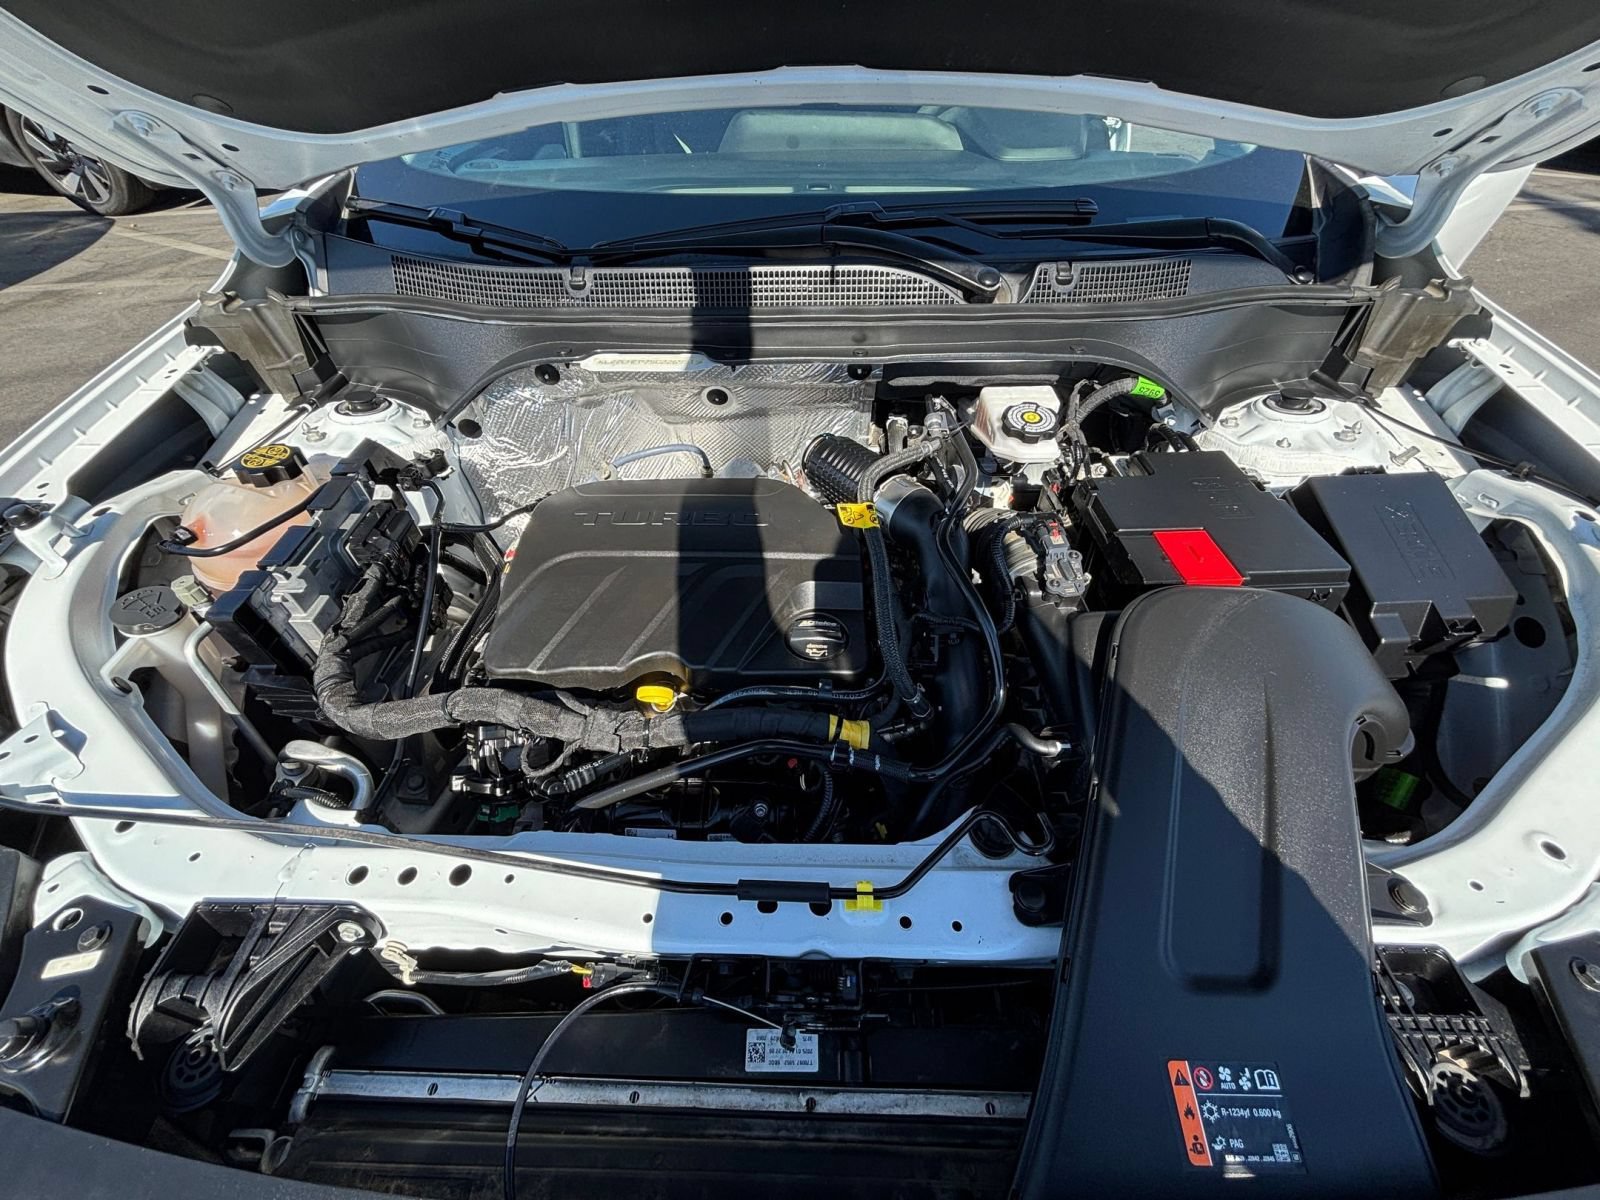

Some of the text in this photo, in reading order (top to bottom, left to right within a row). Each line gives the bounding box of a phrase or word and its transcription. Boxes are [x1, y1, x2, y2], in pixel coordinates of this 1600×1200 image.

[574, 511, 774, 527] TURBO
[1220, 1082, 1237, 1090] AUTO
[1220, 1107, 1282, 1119] R-1234yf 0.600 kg
[1228, 1138, 1245, 1149] PAG
